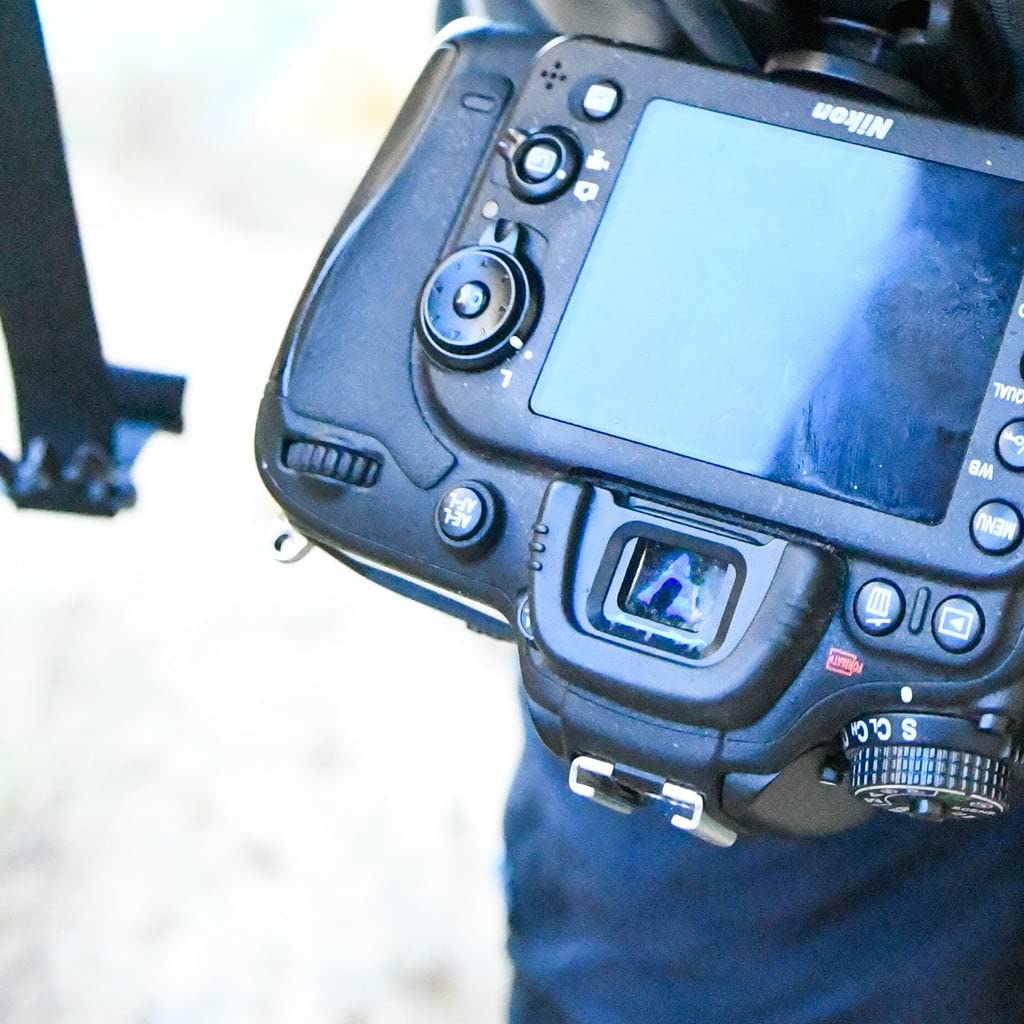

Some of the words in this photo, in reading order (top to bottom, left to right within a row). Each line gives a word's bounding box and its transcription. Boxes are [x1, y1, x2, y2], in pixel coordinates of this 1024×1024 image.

[811, 101, 895, 141] Nikon
[500, 368, 513, 388] L
[968, 459, 994, 481] WB
[449, 491, 478, 514] AF-L
[443, 507, 473, 529] AE-L
[974, 512, 1017, 541] MENU
[901, 717, 917, 742] S
